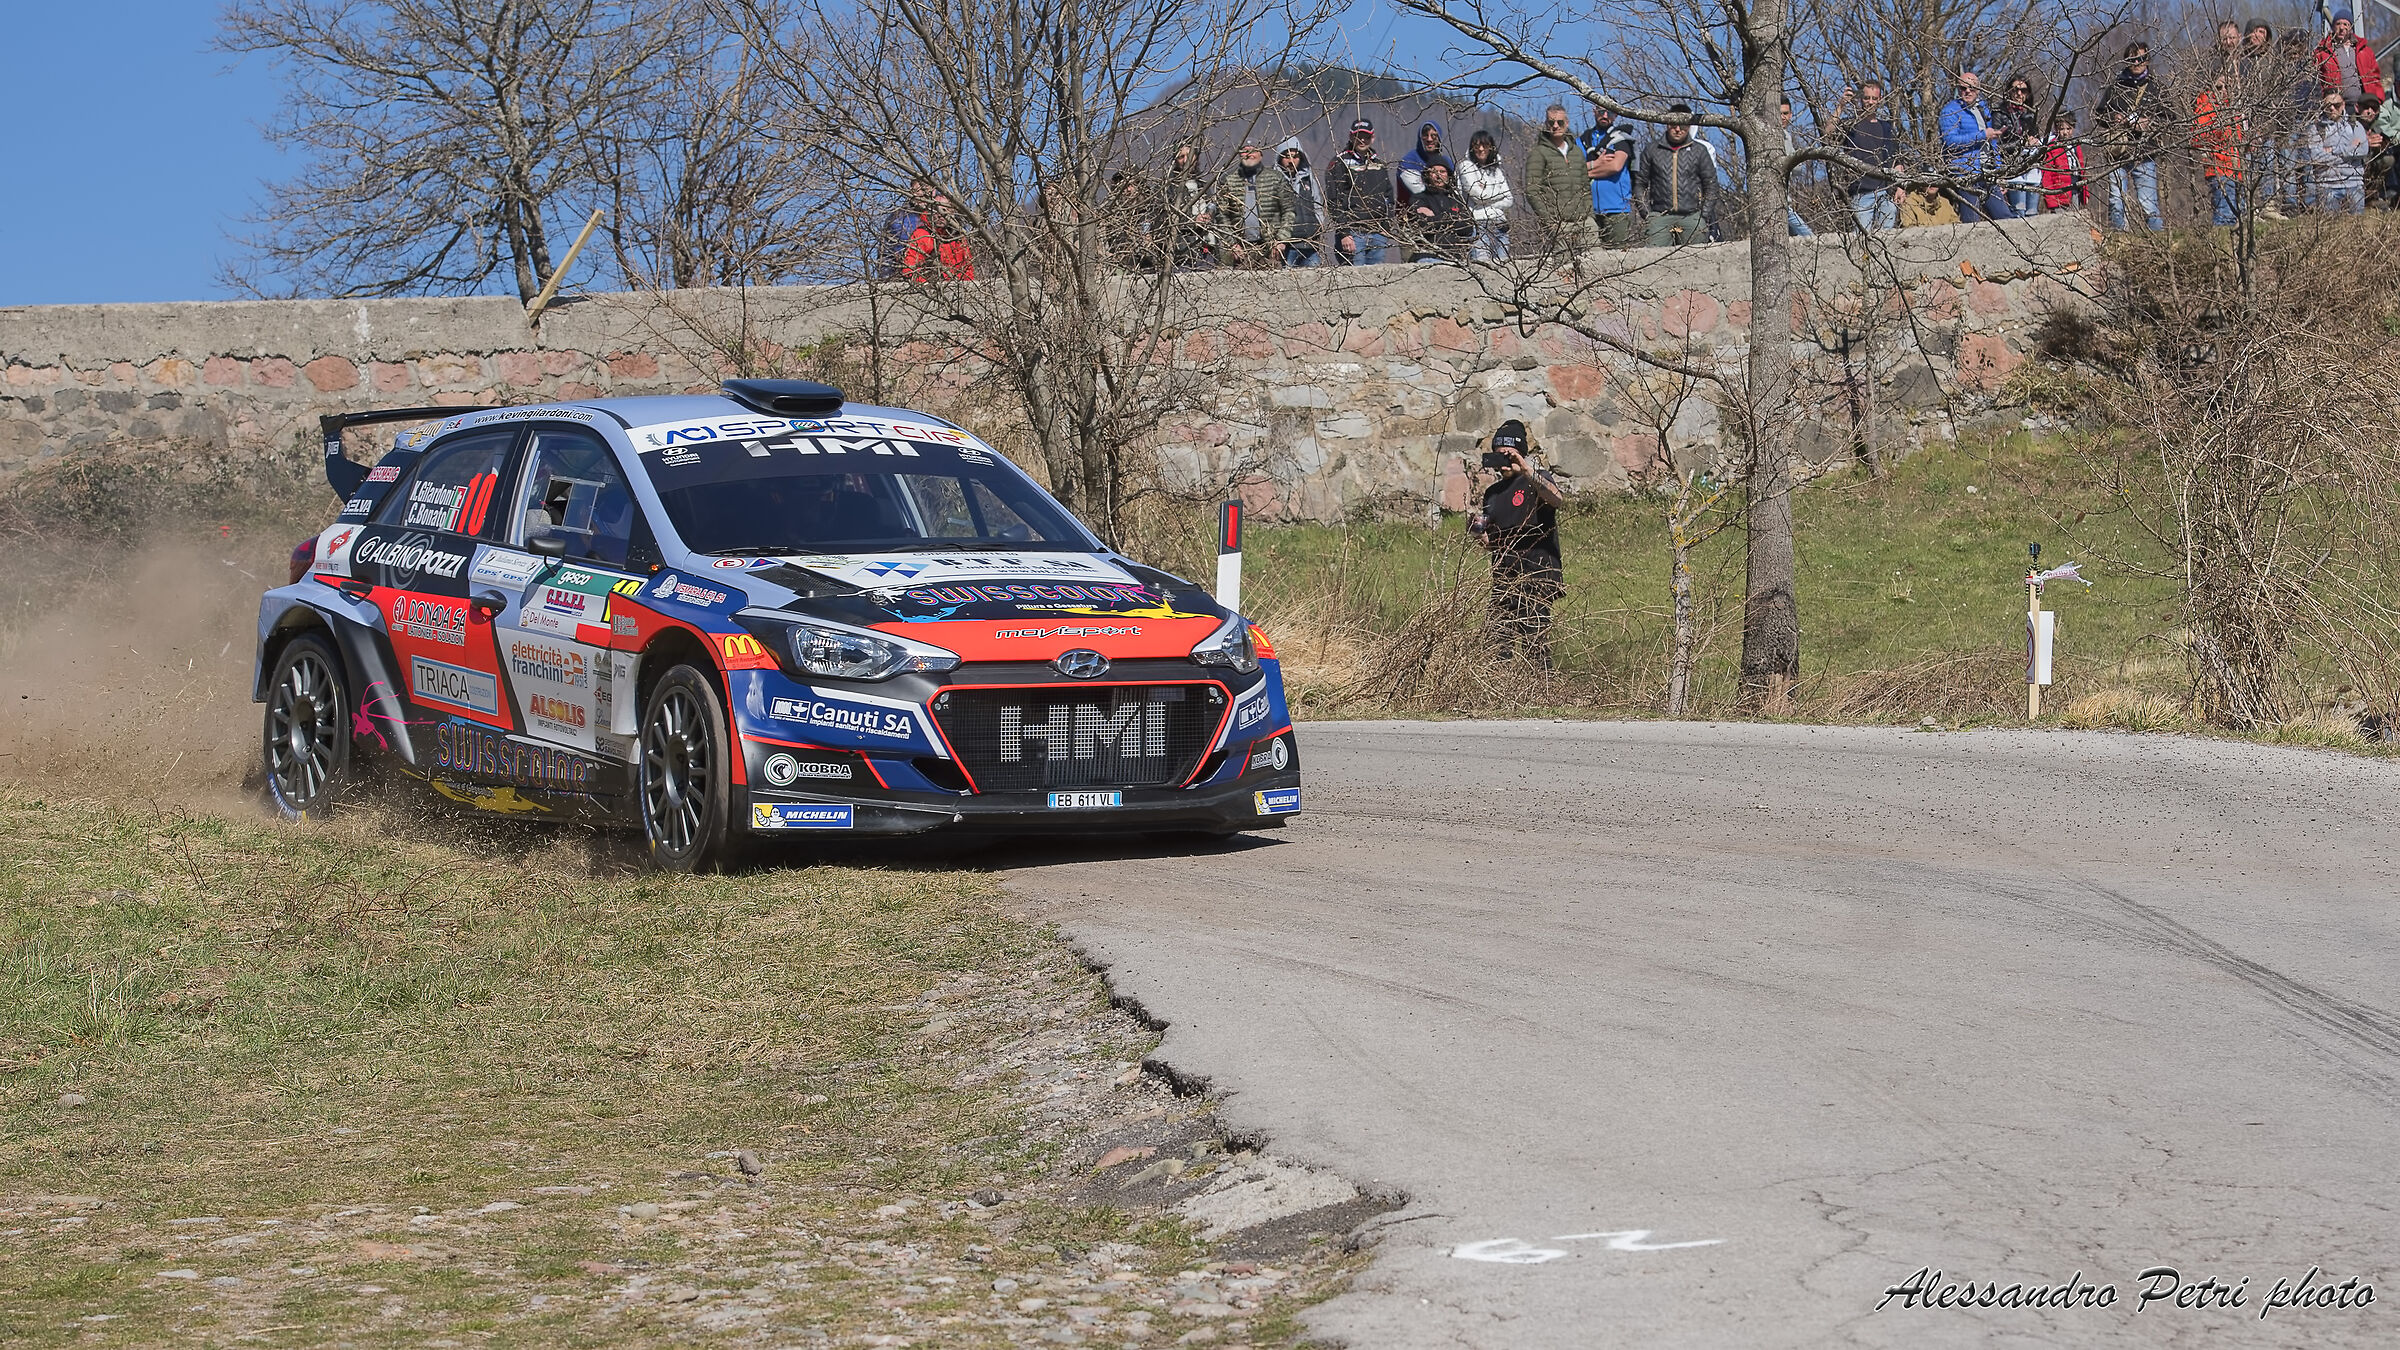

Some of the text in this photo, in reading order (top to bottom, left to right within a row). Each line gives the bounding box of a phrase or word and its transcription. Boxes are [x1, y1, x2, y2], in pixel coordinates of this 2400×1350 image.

[473, 408, 595, 426] www.kevingilardoni.com
[741, 438, 921, 457] HMI
[409, 480, 458, 506] K.Gilardoni
[456, 472, 498, 536] 10
[408, 502, 448, 528] C.Bonato
[905, 585, 1151, 607] SWISSCOLOR
[408, 599, 467, 632] DONADA SA
[529, 611, 559, 629] Del Monte
[995, 625, 1143, 639] movisport
[512, 641, 562, 667] elettricità
[512, 653, 564, 684] franchini
[417, 664, 470, 701] TRIACA
[529, 693, 585, 729] ALSOLIS
[811, 702, 912, 734] Canuti SA
[835, 722, 859, 732] sanitari
[865, 727, 910, 740] riscaldamenti
[1000, 701, 1166, 762] HMI
[799, 763, 851, 775] KOBRA
[1057, 793, 1114, 807] EB 611 VL
[1268, 795, 1298, 805] MICHELIN
[785, 811, 849, 820] MICHELIN
